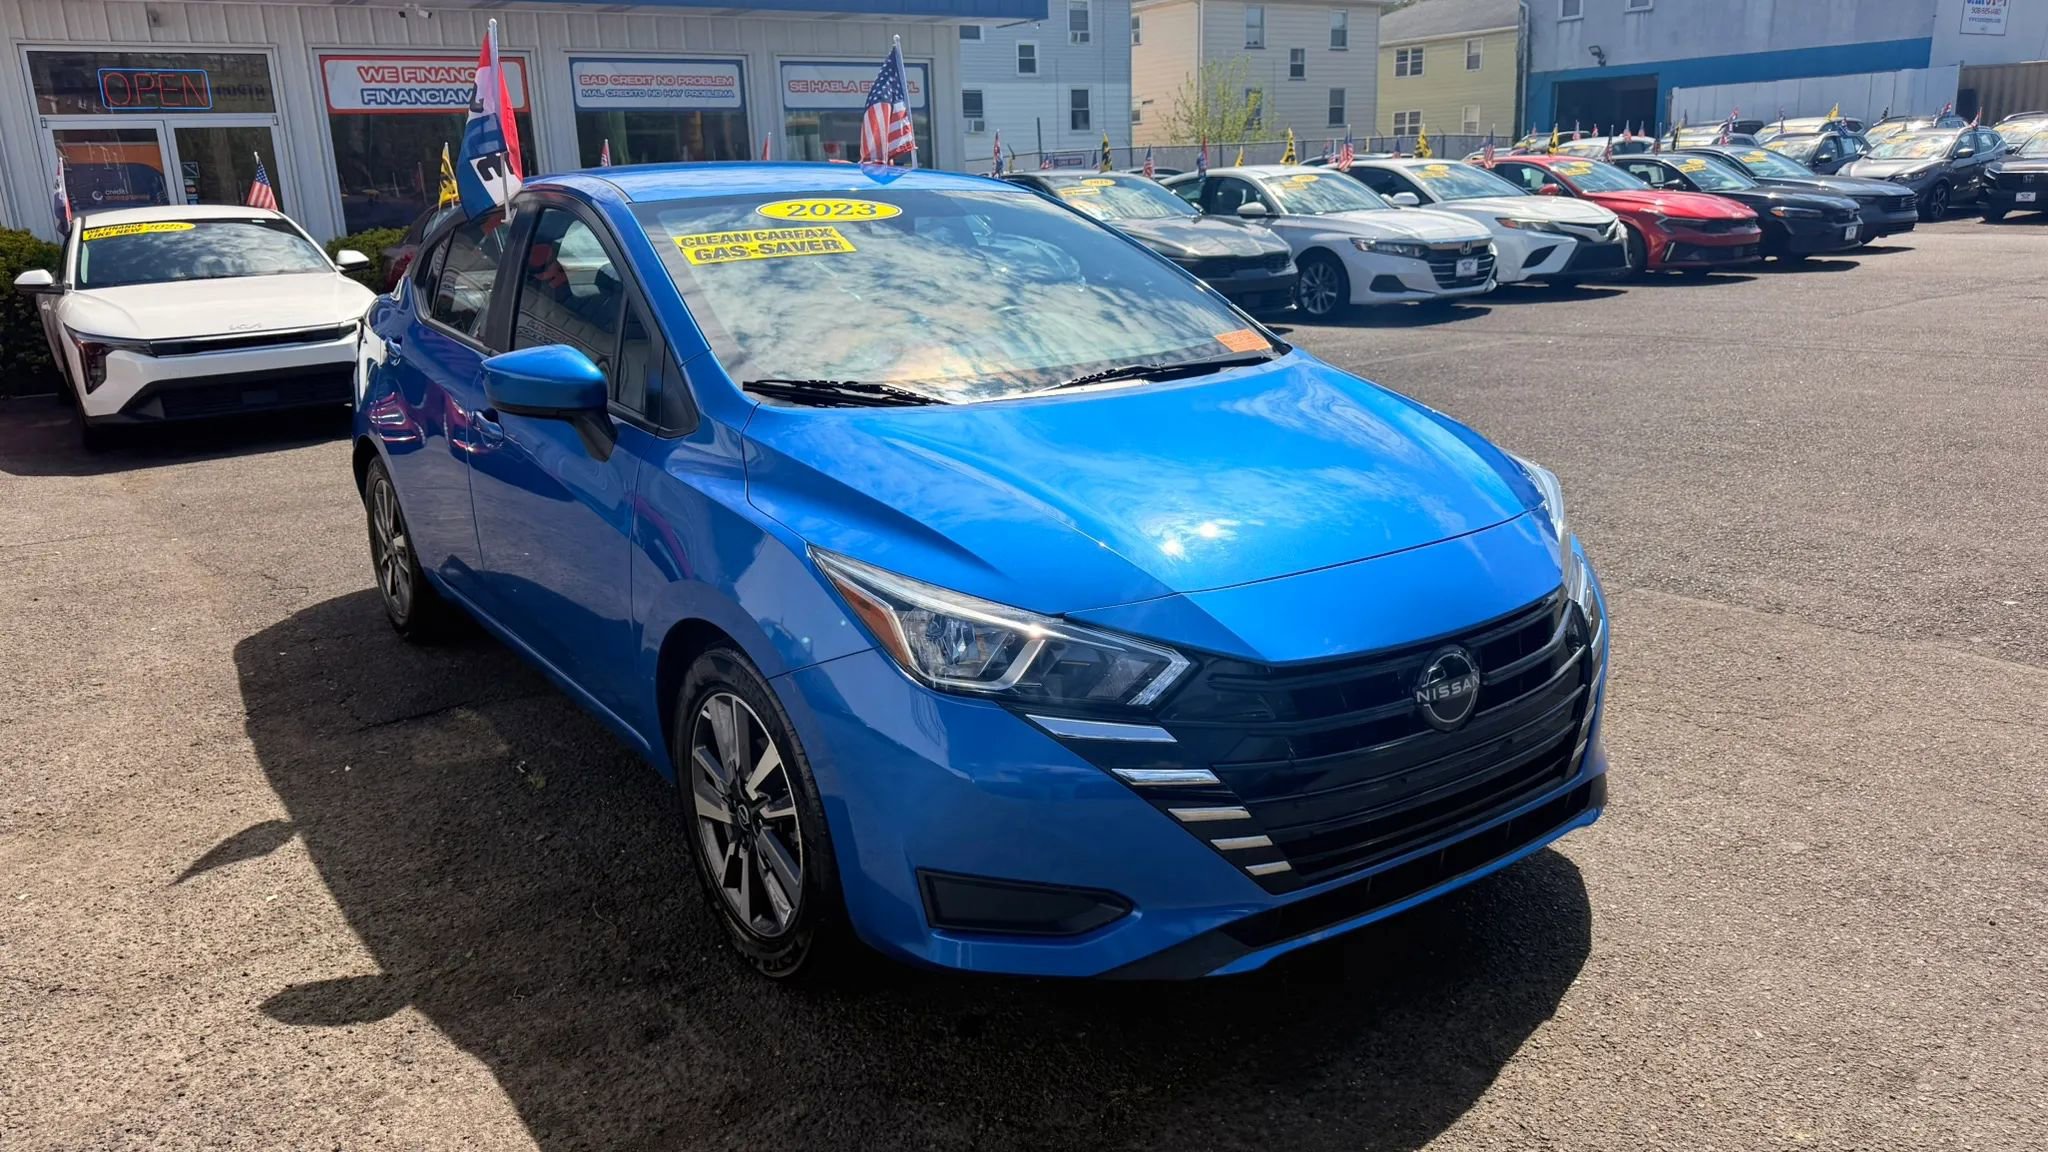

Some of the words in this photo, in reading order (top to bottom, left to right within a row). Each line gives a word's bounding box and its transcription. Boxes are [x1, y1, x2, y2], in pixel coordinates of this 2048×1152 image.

[358, 66, 398, 83] WE
[402, 66, 476, 83] FINANC
[580, 75, 608, 86] BAD
[610, 75, 654, 86] CREDIT
[656, 75, 674, 86] NO
[677, 76, 734, 87] PROBLEM
[103, 72, 209, 107] OPEN
[581, 88, 604, 98] MAL
[606, 89, 646, 98] CREDITO
[647, 89, 662, 98] NO
[664, 89, 683, 98] HAY
[685, 89, 735, 98] PROBLEMA
[788, 80, 809, 93] SE
[810, 80, 857, 93] HABLA
[361, 88, 474, 105] FINANCIAM
[787, 203, 877, 217] 2023
[88, 231, 111, 239] LIKE
[116, 227, 142, 235] NEW
[104, 223, 145, 231] FINANCE
[681, 231, 750, 247] CLEAN
[755, 228, 834, 242] CARFAX
[694, 239, 843, 262] GAS-SAVER
[1416, 674, 1480, 703] NISSAN
